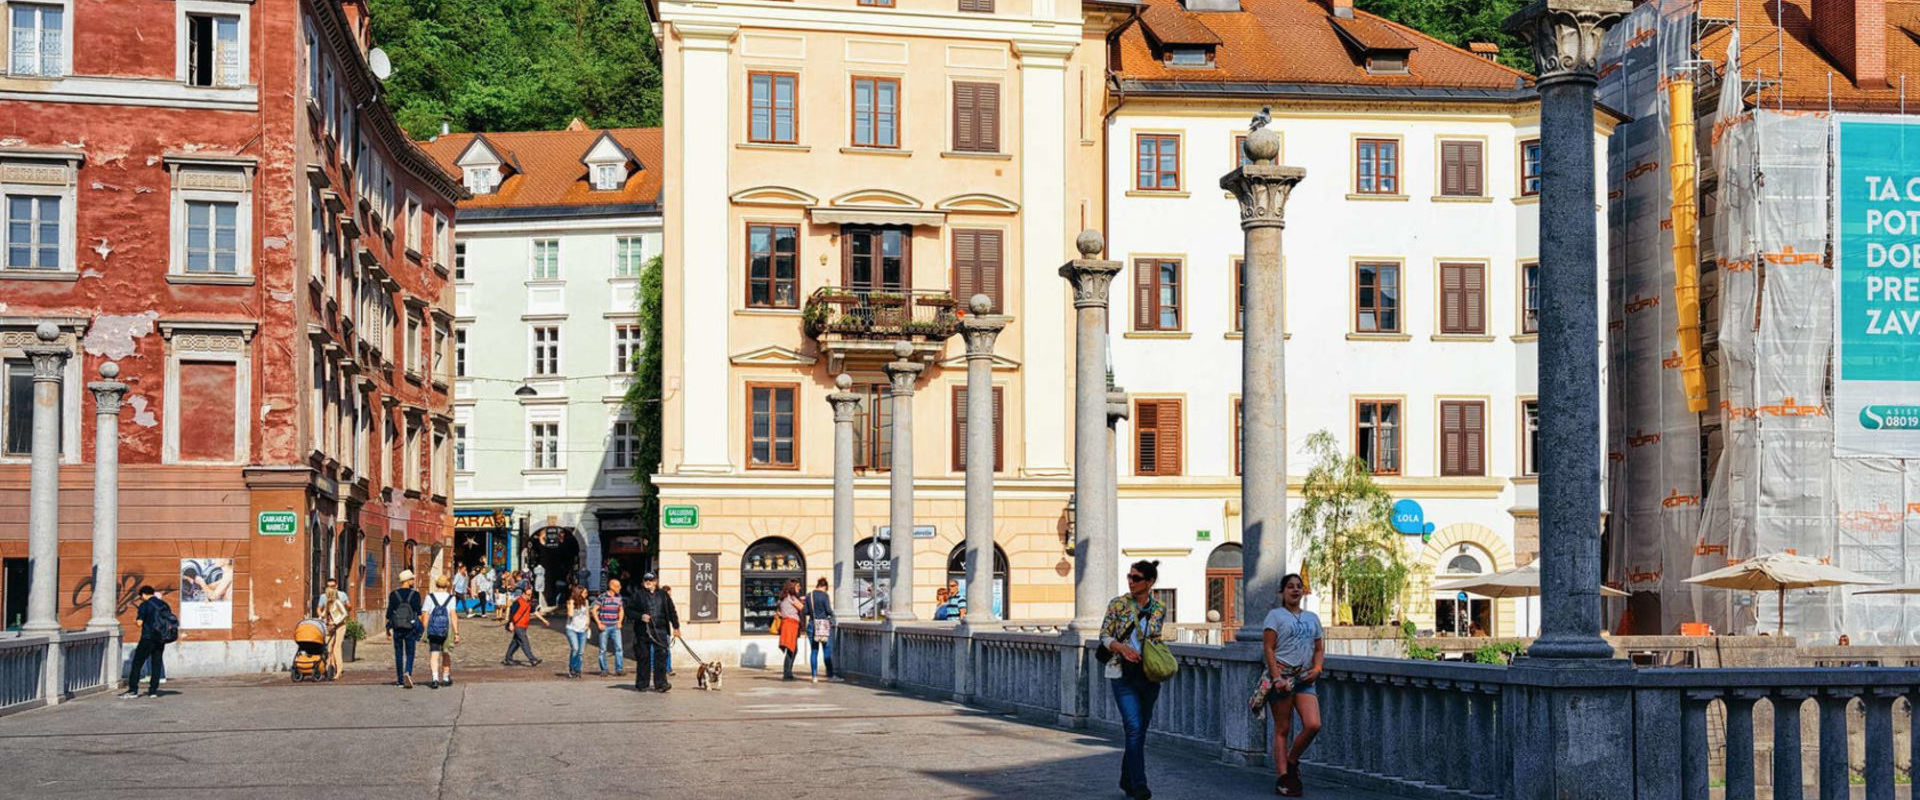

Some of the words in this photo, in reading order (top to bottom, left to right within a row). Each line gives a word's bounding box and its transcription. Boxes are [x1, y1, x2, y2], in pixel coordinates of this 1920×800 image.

[1865, 176, 1901, 202] TA
[1867, 209, 1920, 235] POT
[1866, 309, 1920, 334] ZAV
[1398, 513, 1419, 522] LOLA
[856, 559, 891, 567] VOLCO
